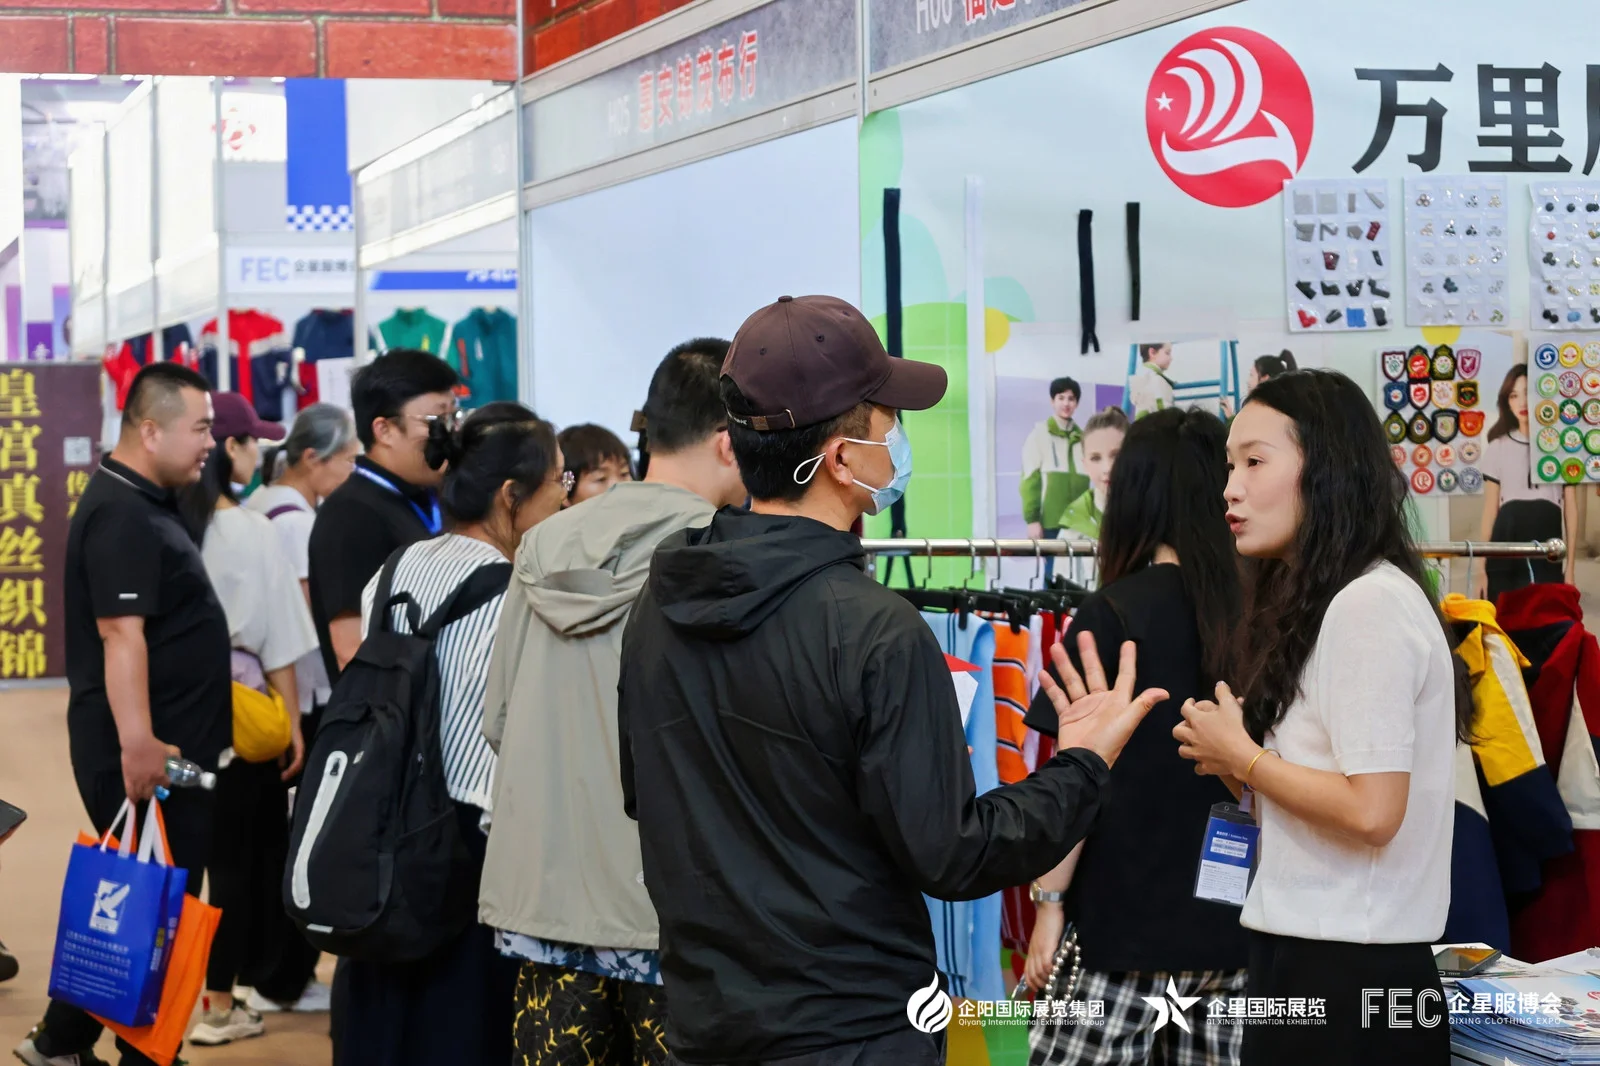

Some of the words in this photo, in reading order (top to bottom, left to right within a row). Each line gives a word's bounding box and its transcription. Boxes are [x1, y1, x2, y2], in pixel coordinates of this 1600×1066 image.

[1351, 61, 1600, 176] 万里
[241, 257, 289, 282] FEC
[0, 368, 47, 678] 皇宫真丝织锦
